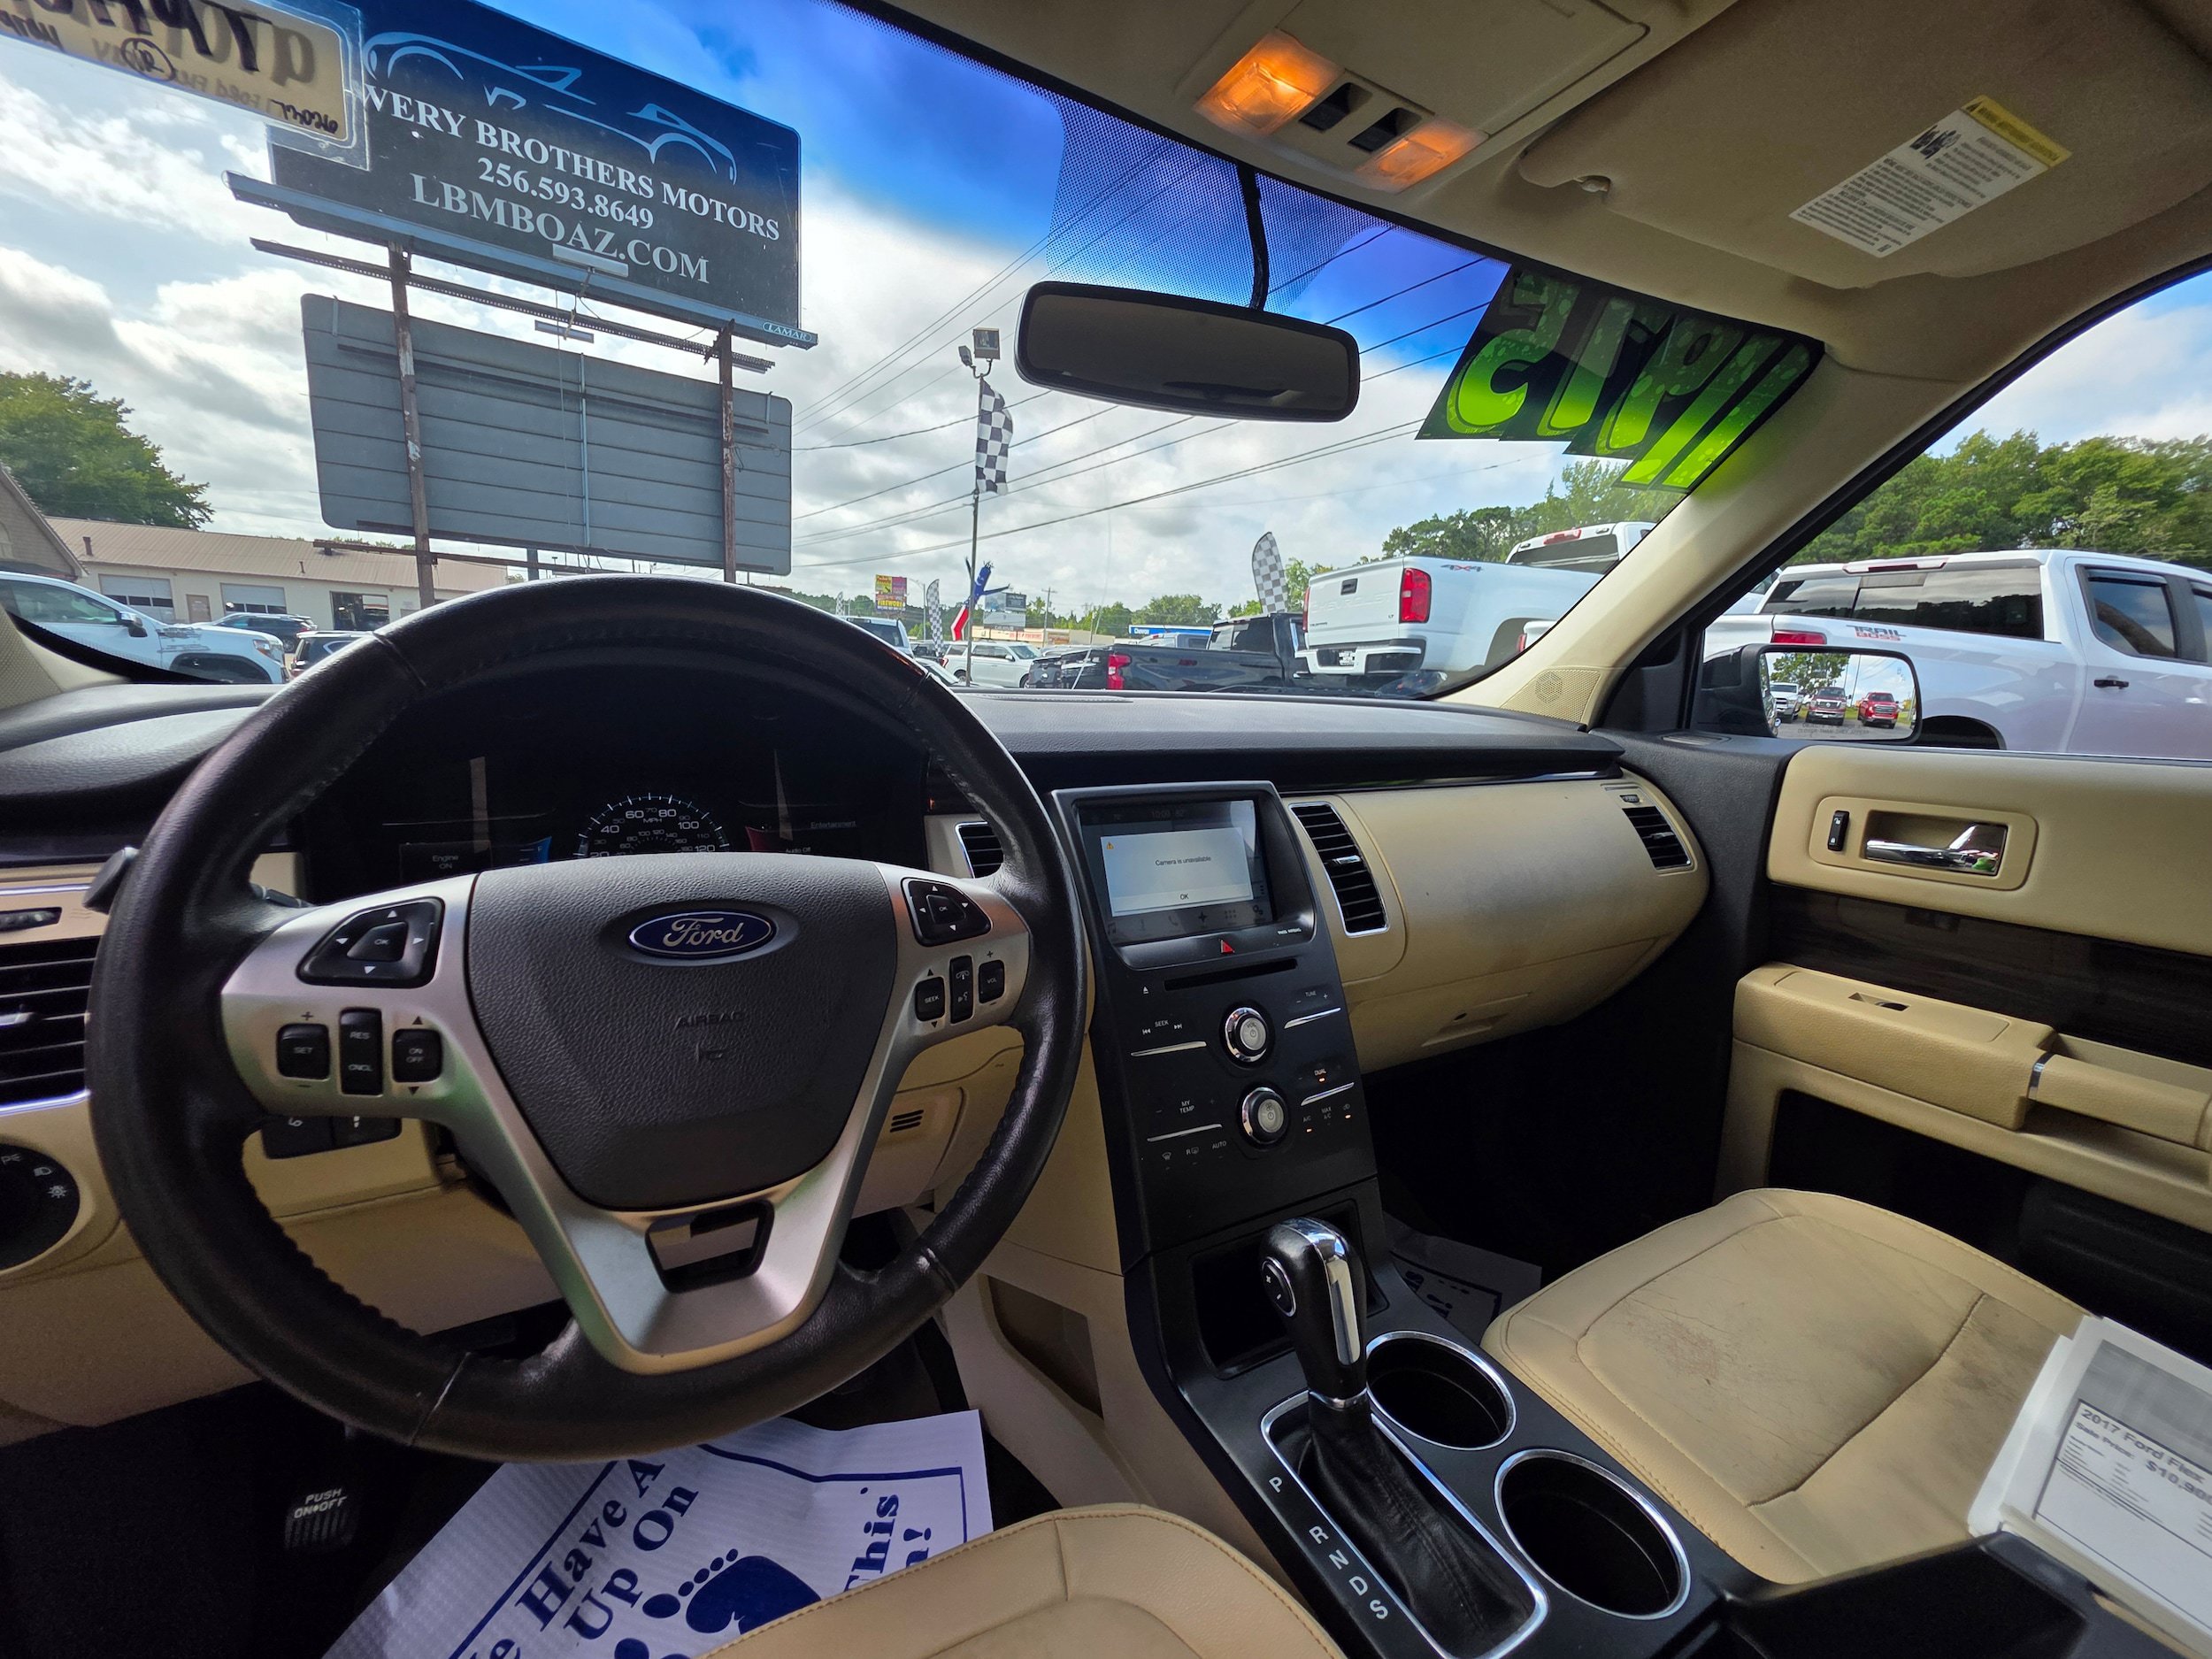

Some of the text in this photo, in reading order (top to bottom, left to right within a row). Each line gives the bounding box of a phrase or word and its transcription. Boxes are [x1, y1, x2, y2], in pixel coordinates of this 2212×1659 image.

[475, 119, 655, 199] BROTHERS
[660, 182, 780, 241] MOTORS
[477, 157, 655, 230] 256.593.8649
[409, 173, 710, 284] LBMBOAZ.COM
[768, 323, 807, 341] LAMAR
[1846, 624, 1907, 638] TRAIL
[625, 810, 644, 819] 60
[658, 809, 677, 818] 80
[600, 825, 619, 833] 40
[678, 821, 700, 830] 100
[1183, 856, 1211, 864] unavailable
[663, 917, 744, 948] Ford
[924, 995, 940, 1004] SEEK
[675, 1010, 743, 1029] AIRBAG
[1154, 1019, 1169, 1028] SEEK
[1179, 1105, 1194, 1114] TEMP
[2074, 1422, 2101, 1439] Sale
[2081, 1409, 2206, 1485] 2017 Ford Flex
[304, 1487, 342, 1505] PUSH
[514, 1459, 665, 1632] Have A
[1268, 1476, 1389, 1620] P R N D S
[563, 1486, 700, 1640] Up On
